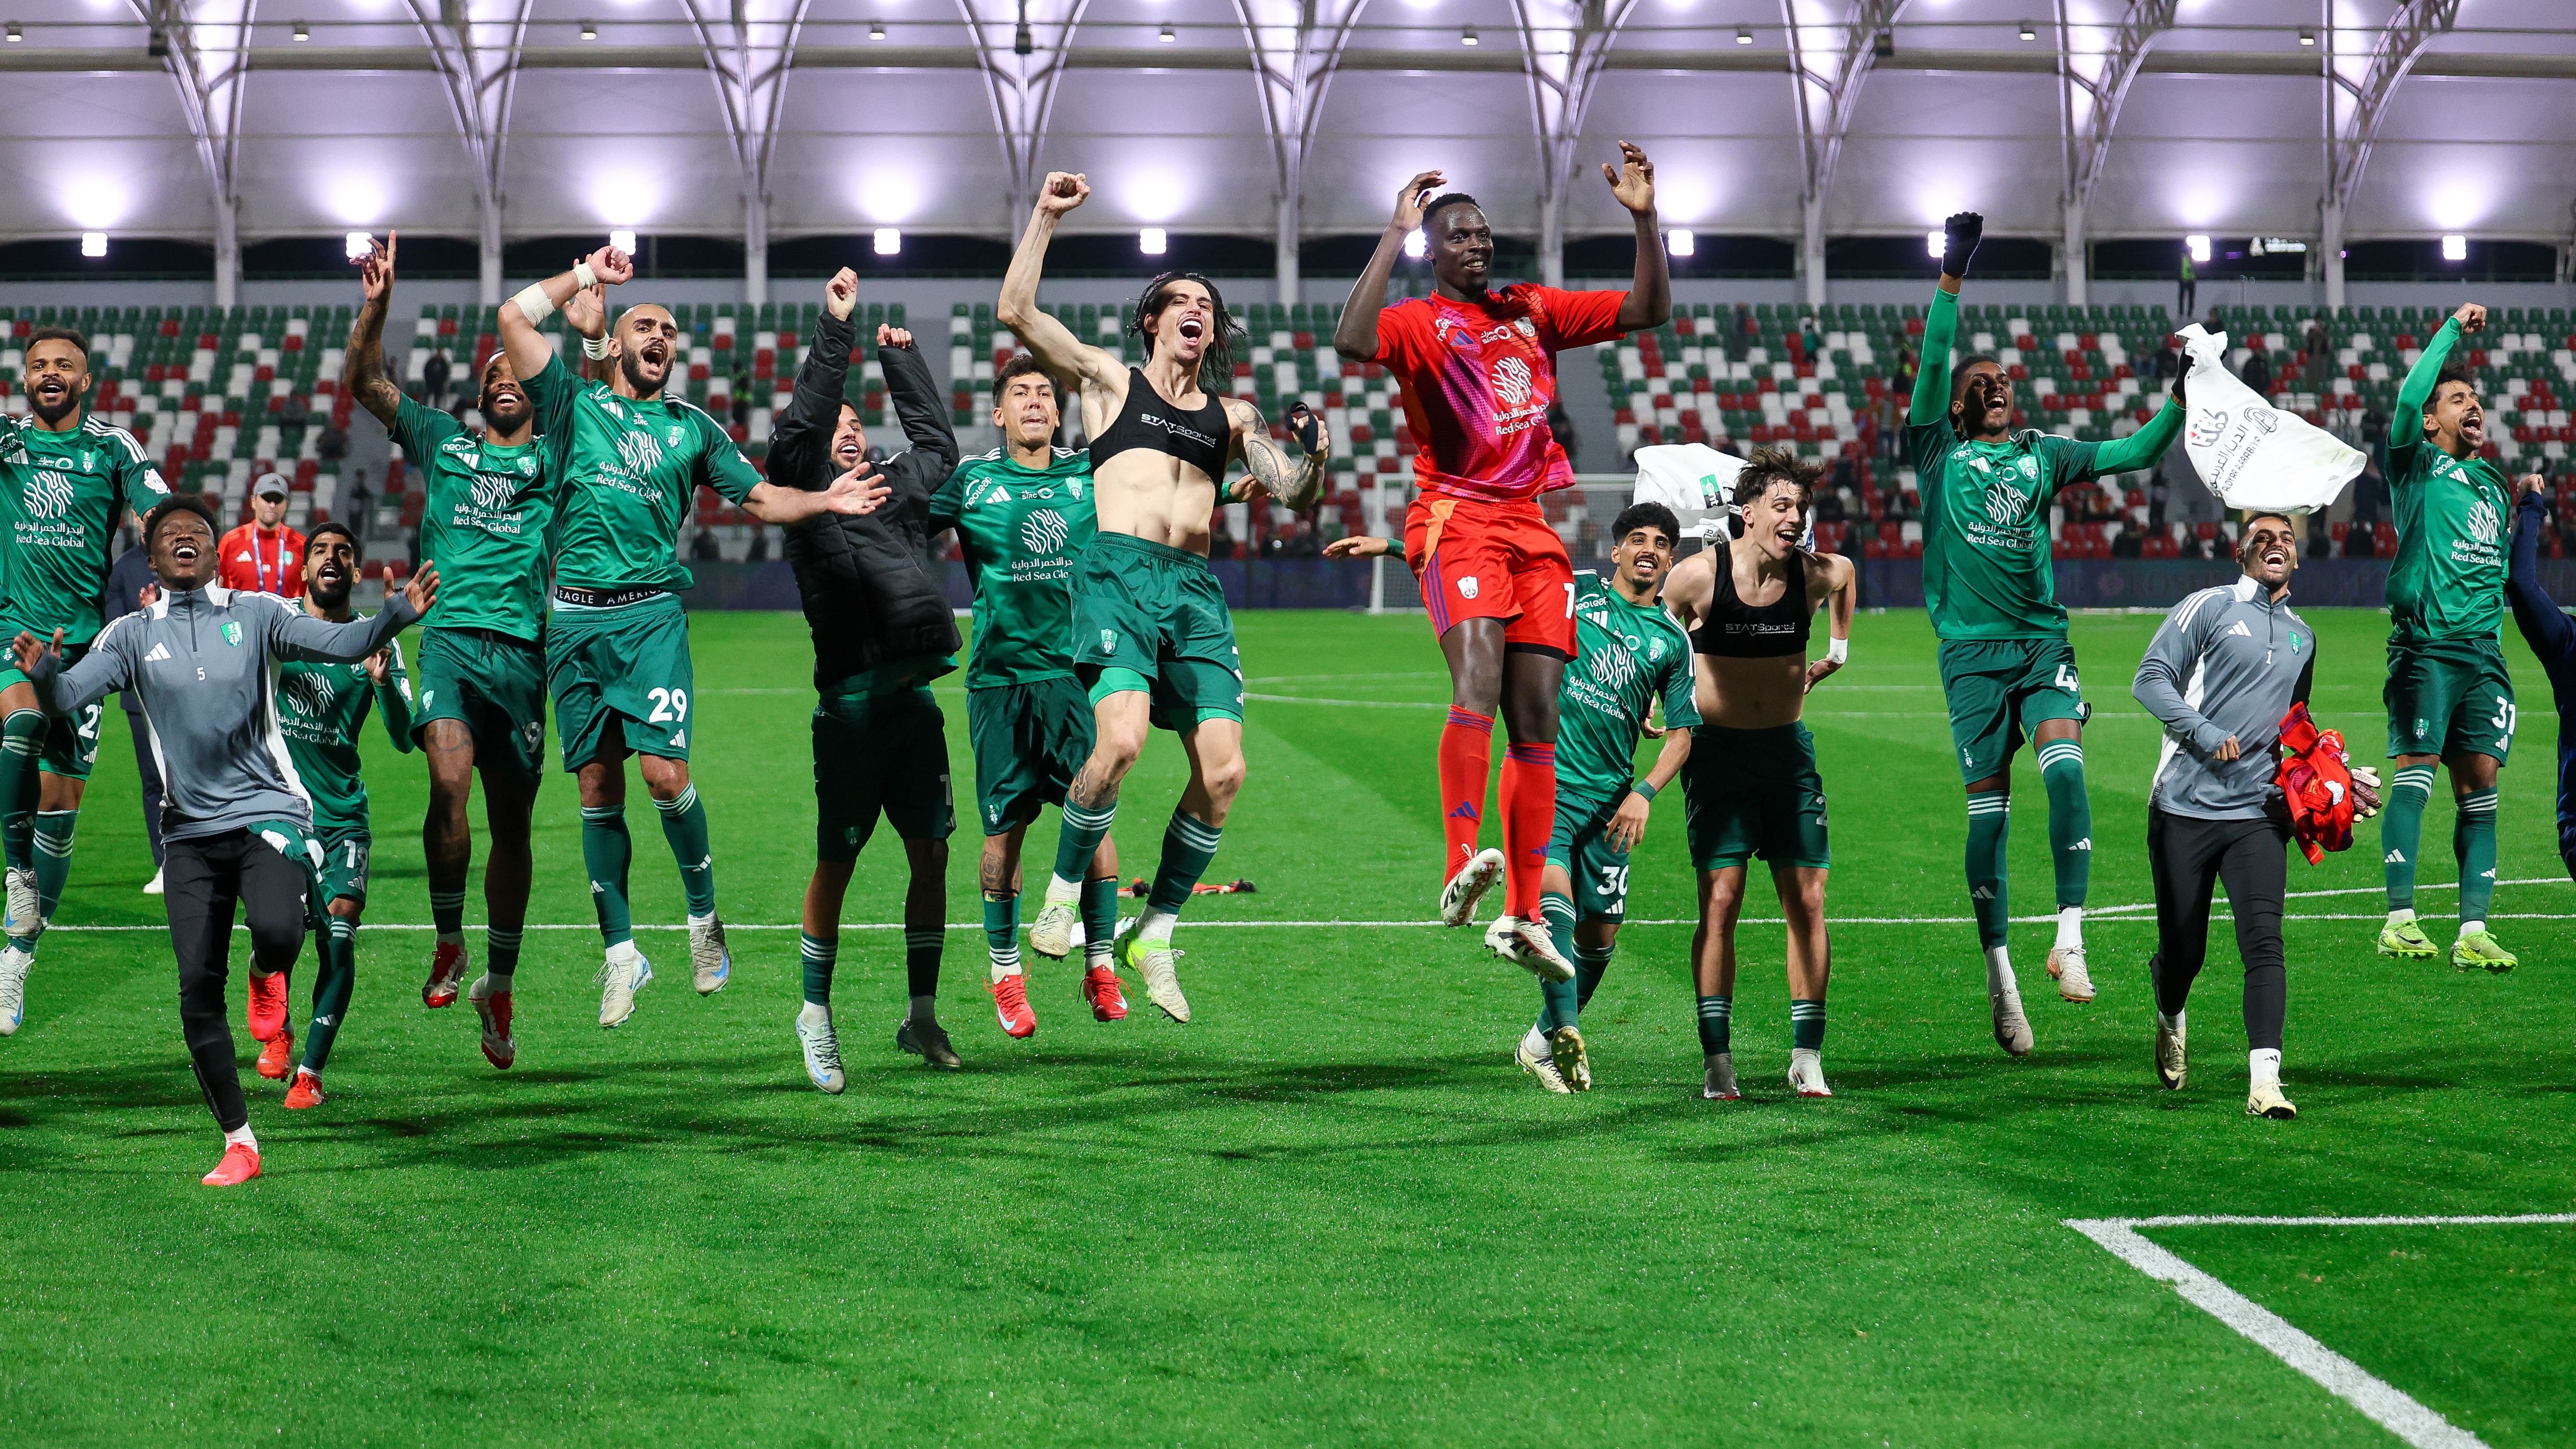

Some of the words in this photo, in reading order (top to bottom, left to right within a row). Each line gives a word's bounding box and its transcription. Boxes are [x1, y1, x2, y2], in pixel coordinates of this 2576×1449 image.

[1482, 335, 1498, 344] SIRC
[1495, 425, 1514, 436] Red
[1514, 420, 1530, 431] Sea
[596, 473, 617, 487] Red
[617, 479, 637, 494] Sea
[965, 476, 993, 510] neoleap
[453, 516, 469, 525] Red
[487, 522, 520, 534] Global
[1968, 521, 1997, 533] الدولية
[16, 534, 32, 544] Red
[52, 536, 85, 548] Global
[1967, 533, 1986, 544] Red
[1987, 536, 2005, 547] Sea
[2452, 539, 2480, 551] الدولية
[1011, 558, 1040, 570] الدولية
[2451, 551, 2469, 562] Red
[2469, 554, 2485, 565] Sea
[2485, 556, 2503, 567] Globa
[1013, 572, 1032, 582] Red
[1034, 571, 1051, 581] Sea
[1052, 569, 1068, 579] Glo
[559, 589, 594, 604] EAGLE
[2266, 649, 2272, 665] 1
[196, 667, 206, 681] 5
[2055, 664, 2080, 692] 4
[1569, 675, 1597, 695] الدولية
[647, 686, 688, 723] 29
[1566, 686, 1584, 701] Red
[1583, 695, 1600, 709] Sea
[1600, 702, 1627, 720] Global
[2492, 695, 2516, 735] 31
[278, 725, 292, 735] ed
[292, 729, 308, 741] Sea
